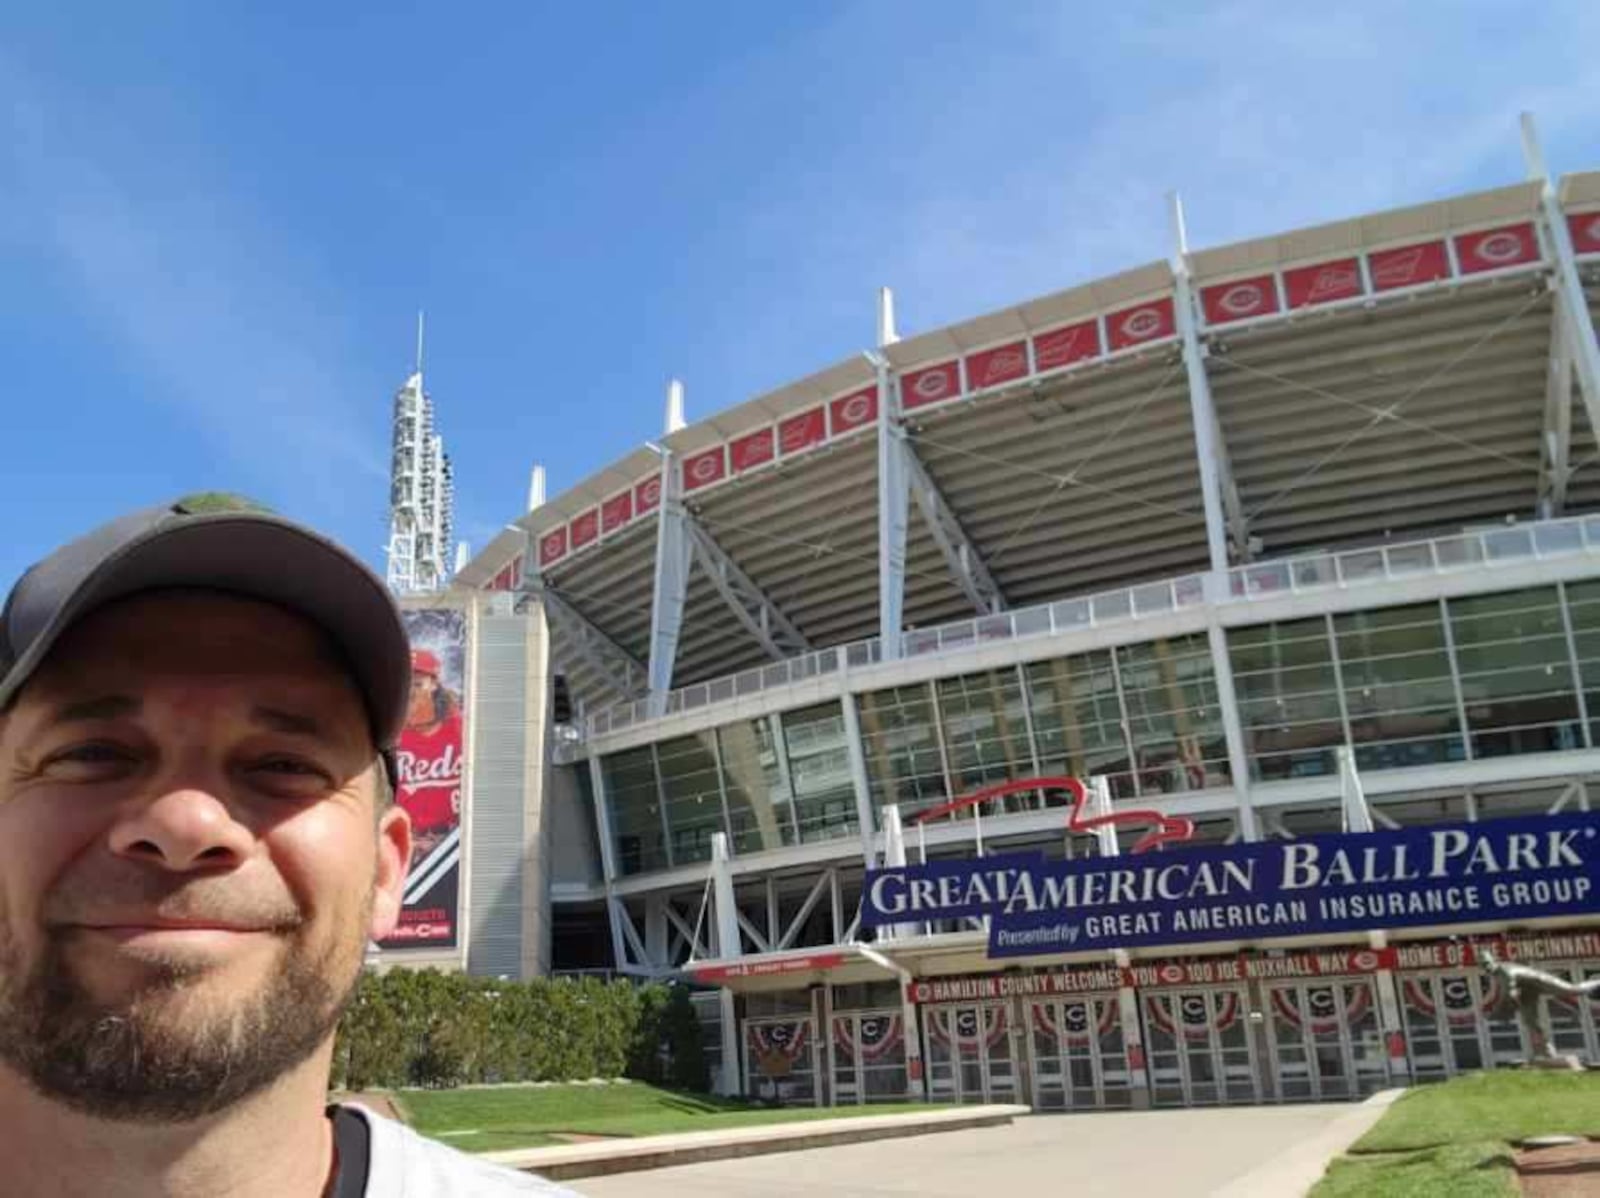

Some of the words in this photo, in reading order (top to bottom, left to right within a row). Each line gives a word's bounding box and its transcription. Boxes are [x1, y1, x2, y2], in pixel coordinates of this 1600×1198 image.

[870, 868, 1016, 914] GREAT
[1003, 858, 1256, 914] AMERICAN
[1279, 843, 1420, 889] BALL
[1428, 829, 1584, 877] PARK
[1085, 912, 1162, 938] GREAT
[1173, 901, 1307, 931] AMERICAN
[1319, 886, 1480, 919] INSURANCE
[1492, 877, 1592, 906] GROUP
[1246, 954, 1313, 978] NUXHALL
[1317, 950, 1349, 973] WAY
[1397, 945, 1443, 968] HOME
[1446, 944, 1465, 966] OF
[933, 979, 995, 1003] HAMILTON
[999, 974, 1048, 997] COUNTY
[1053, 969, 1122, 993] WELCOMES
[1130, 966, 1158, 986] YOU
